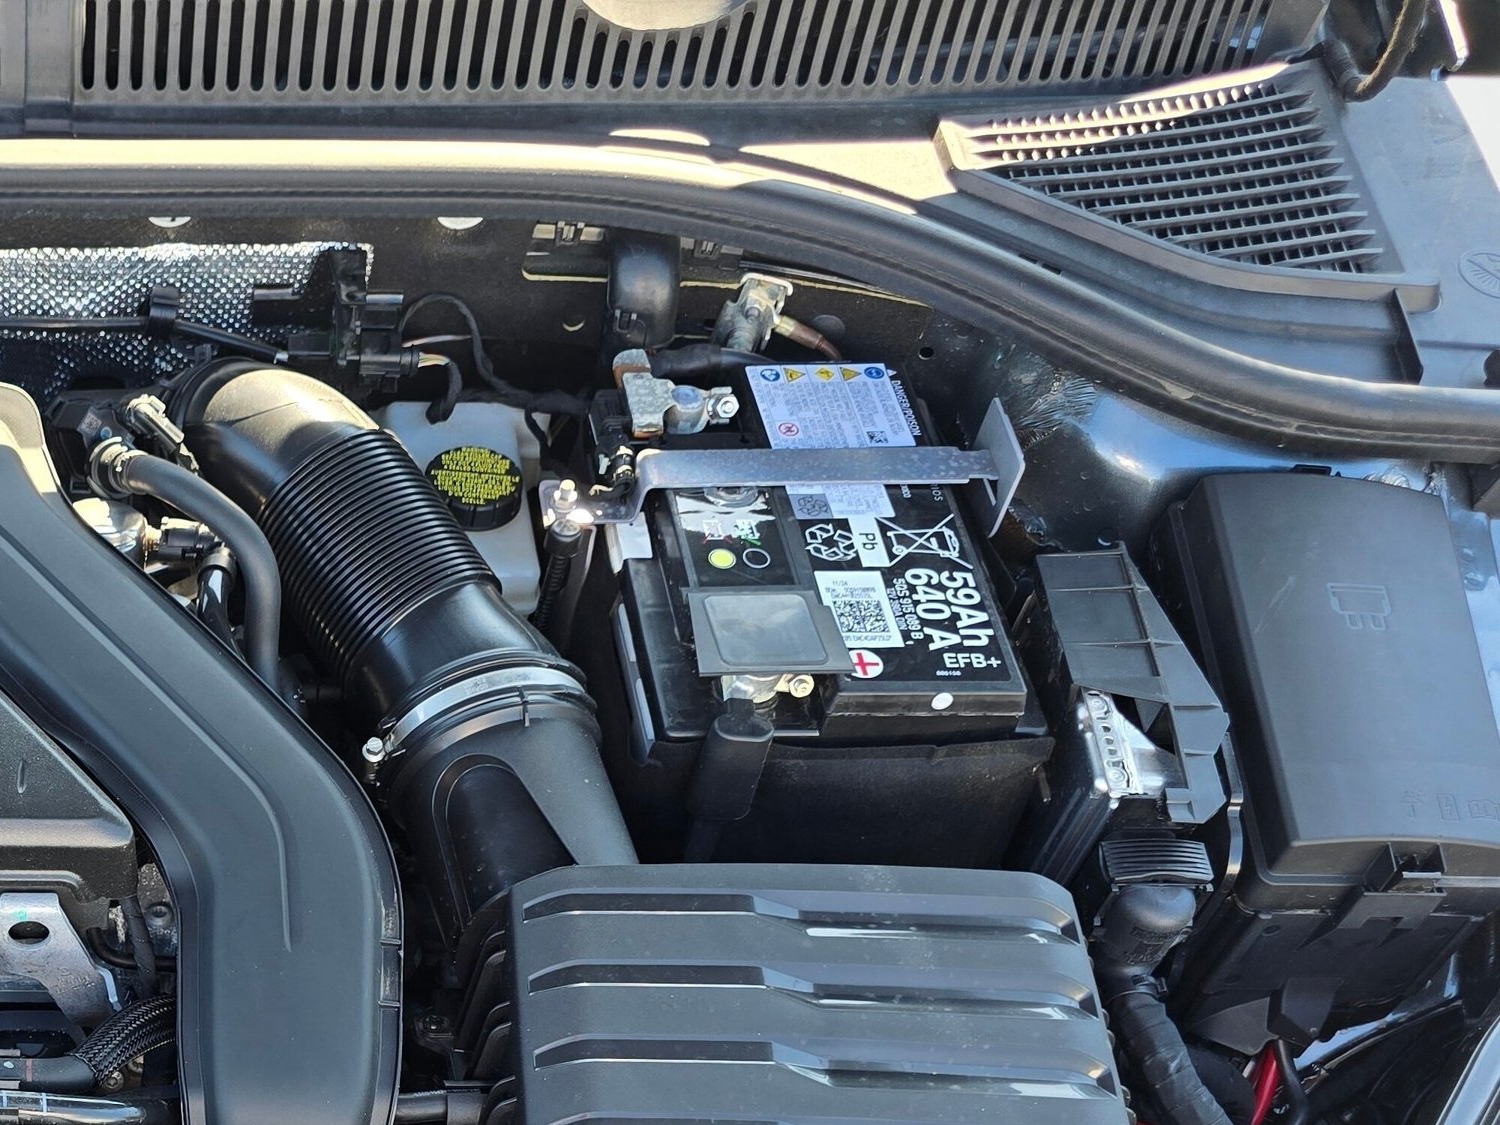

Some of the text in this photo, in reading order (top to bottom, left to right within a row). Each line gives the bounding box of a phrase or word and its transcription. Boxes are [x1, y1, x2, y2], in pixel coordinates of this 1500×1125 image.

[891, 380, 922, 436] DANGER/POISON
[859, 533, 878, 550] Pb
[904, 568, 952, 620] 640
[939, 570, 995, 647] 59Ah
[899, 598, 916, 614] 915
[910, 632, 924, 640] B
[922, 626, 962, 650] A
[943, 653, 1001, 668] EFB+
